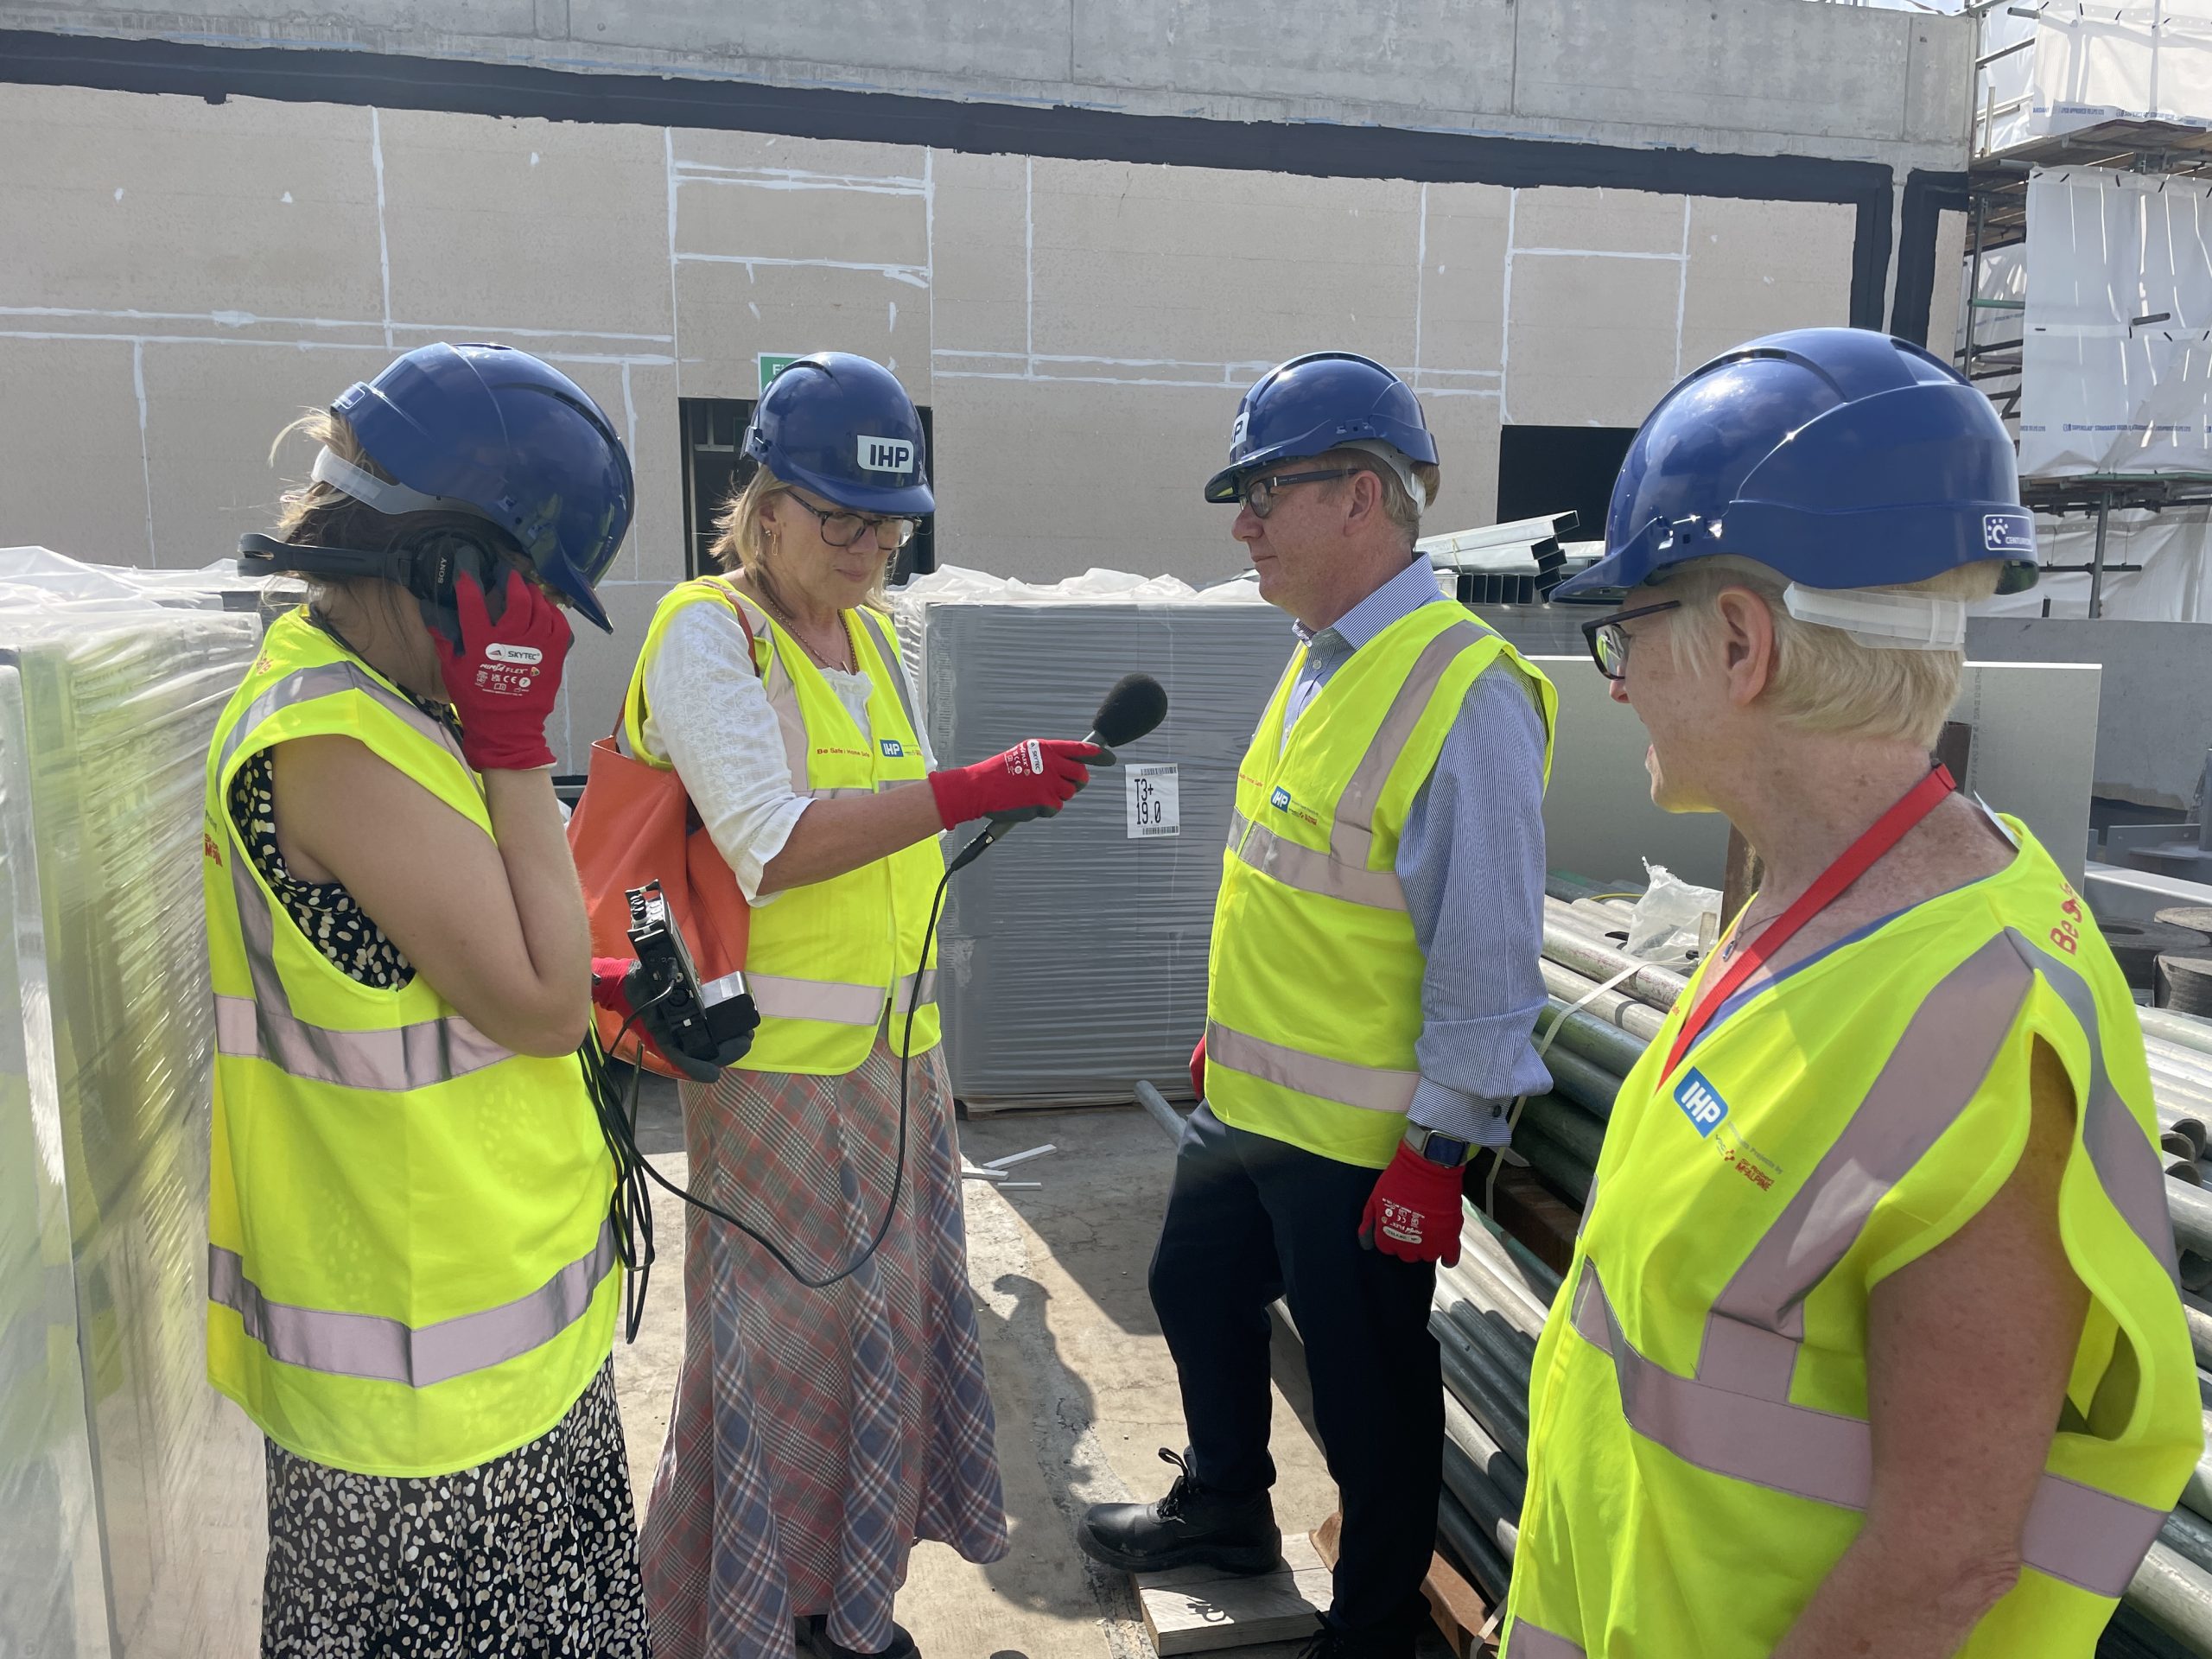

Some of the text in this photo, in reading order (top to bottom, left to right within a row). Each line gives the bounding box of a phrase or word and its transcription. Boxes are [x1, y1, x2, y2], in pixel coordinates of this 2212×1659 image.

[870, 444, 909, 467] IHP
[438, 557, 447, 583] SONY
[508, 651, 537, 660] SKYTEC
[883, 743, 900, 755] IHP
[1135, 779, 1154, 802] T3+
[1272, 791, 1288, 807] IHP
[1136, 801, 1161, 824] 19.0
[2050, 920, 2079, 955] Be
[1681, 1081, 1721, 1123] IHP
